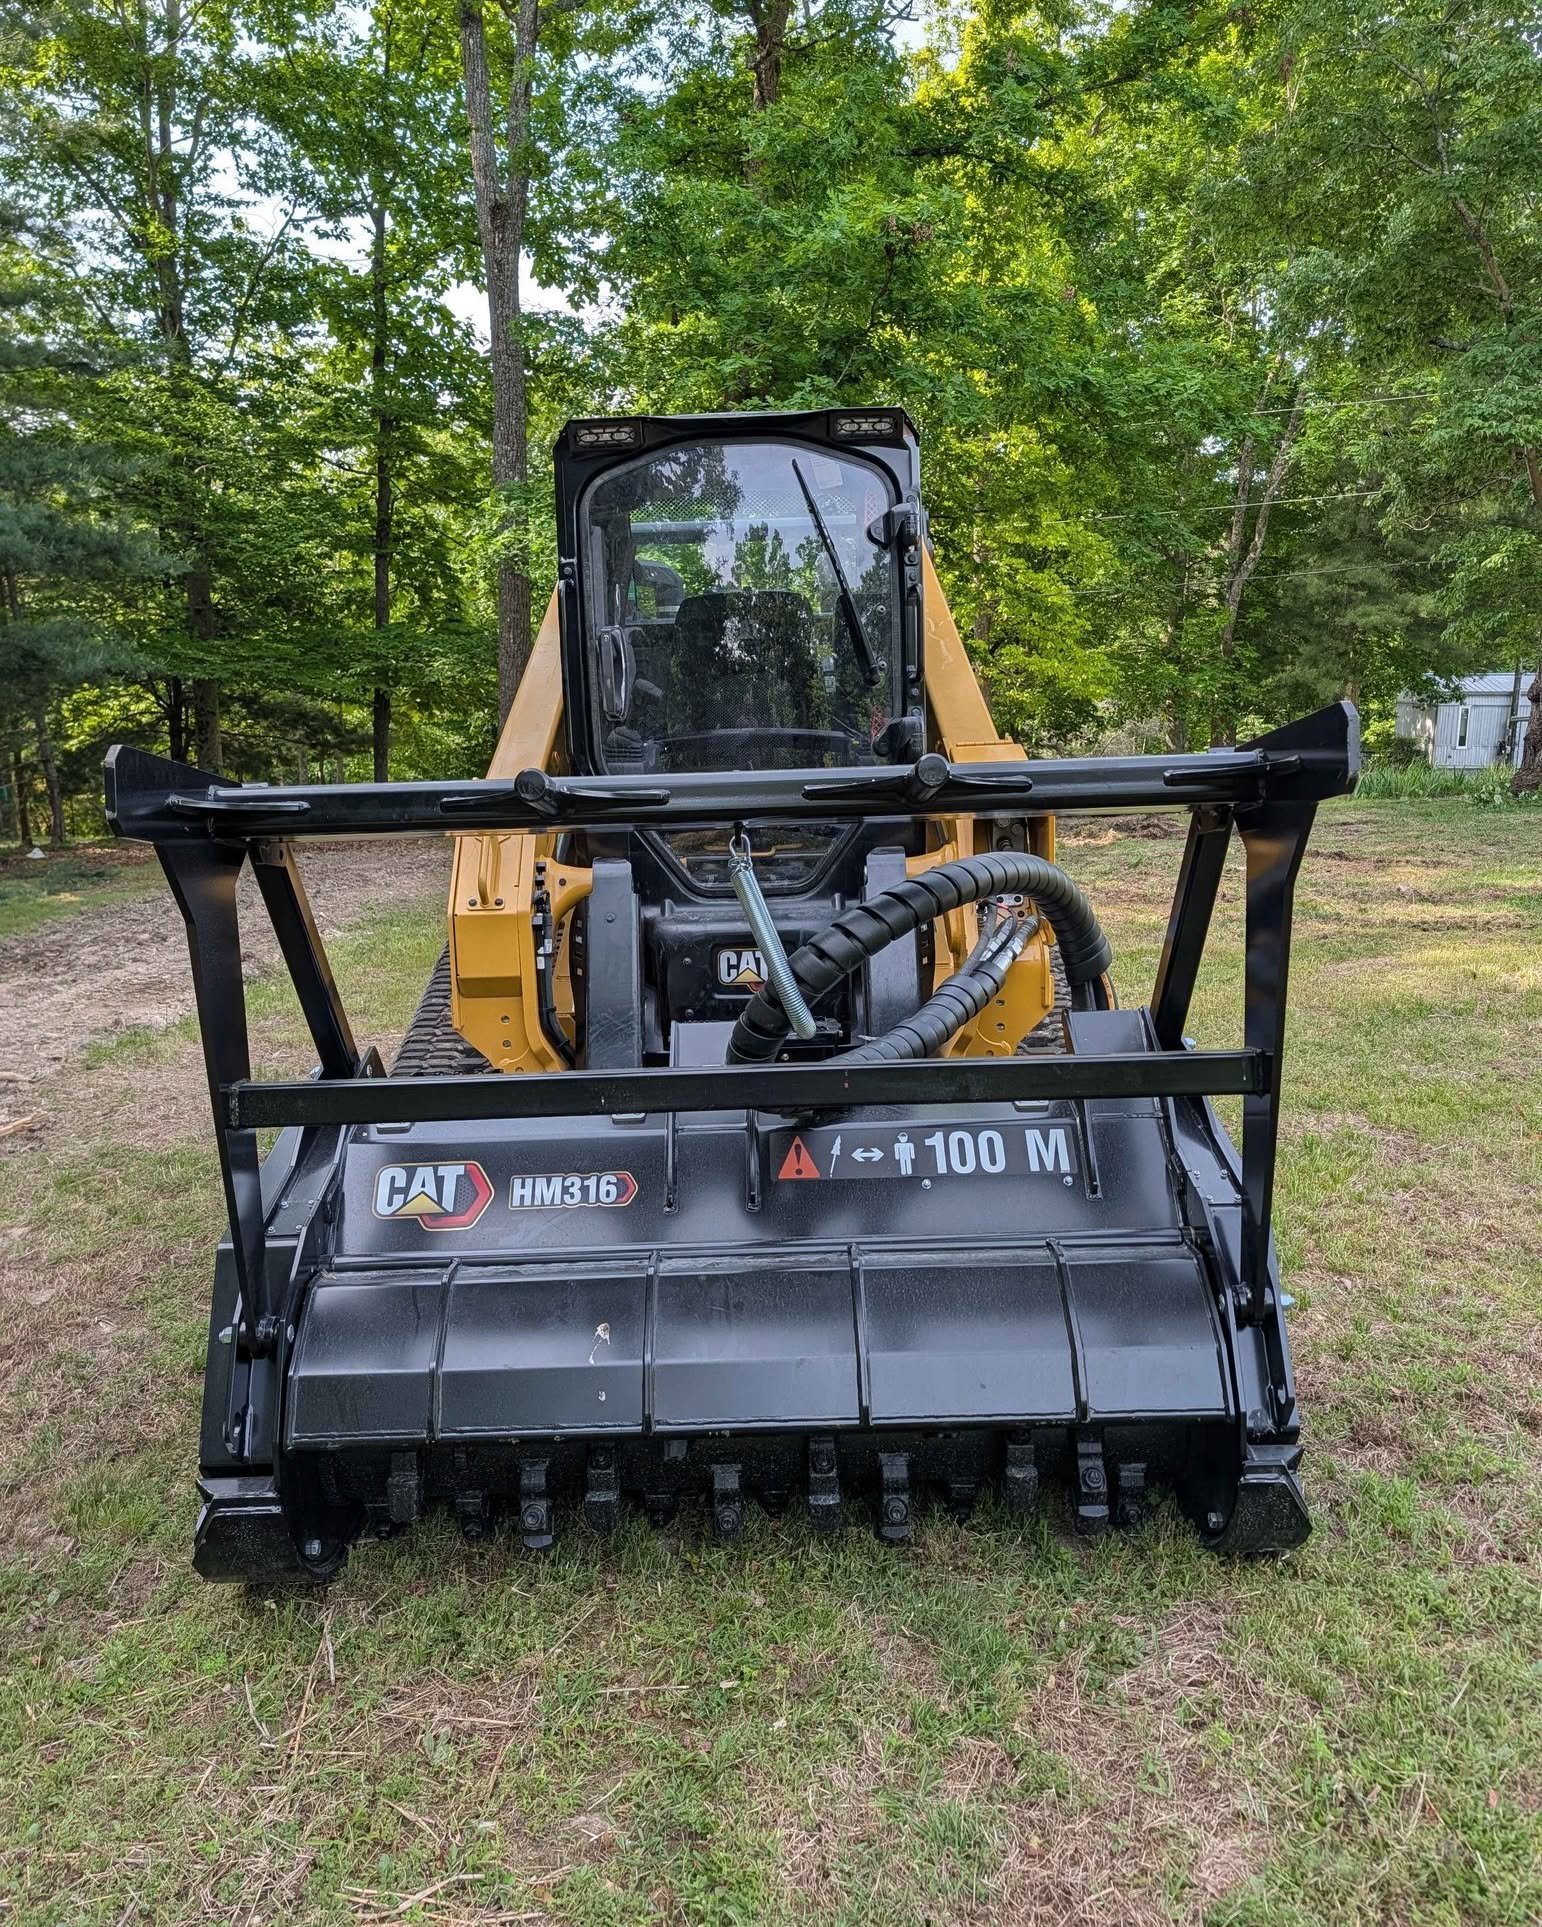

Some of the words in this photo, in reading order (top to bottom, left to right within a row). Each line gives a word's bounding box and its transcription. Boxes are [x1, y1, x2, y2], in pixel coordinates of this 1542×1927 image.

[925, 1131, 1005, 1174] 100
[1025, 1128, 1072, 1174] M
[377, 1164, 465, 1216] CAT
[511, 1176, 618, 1206] HM316
